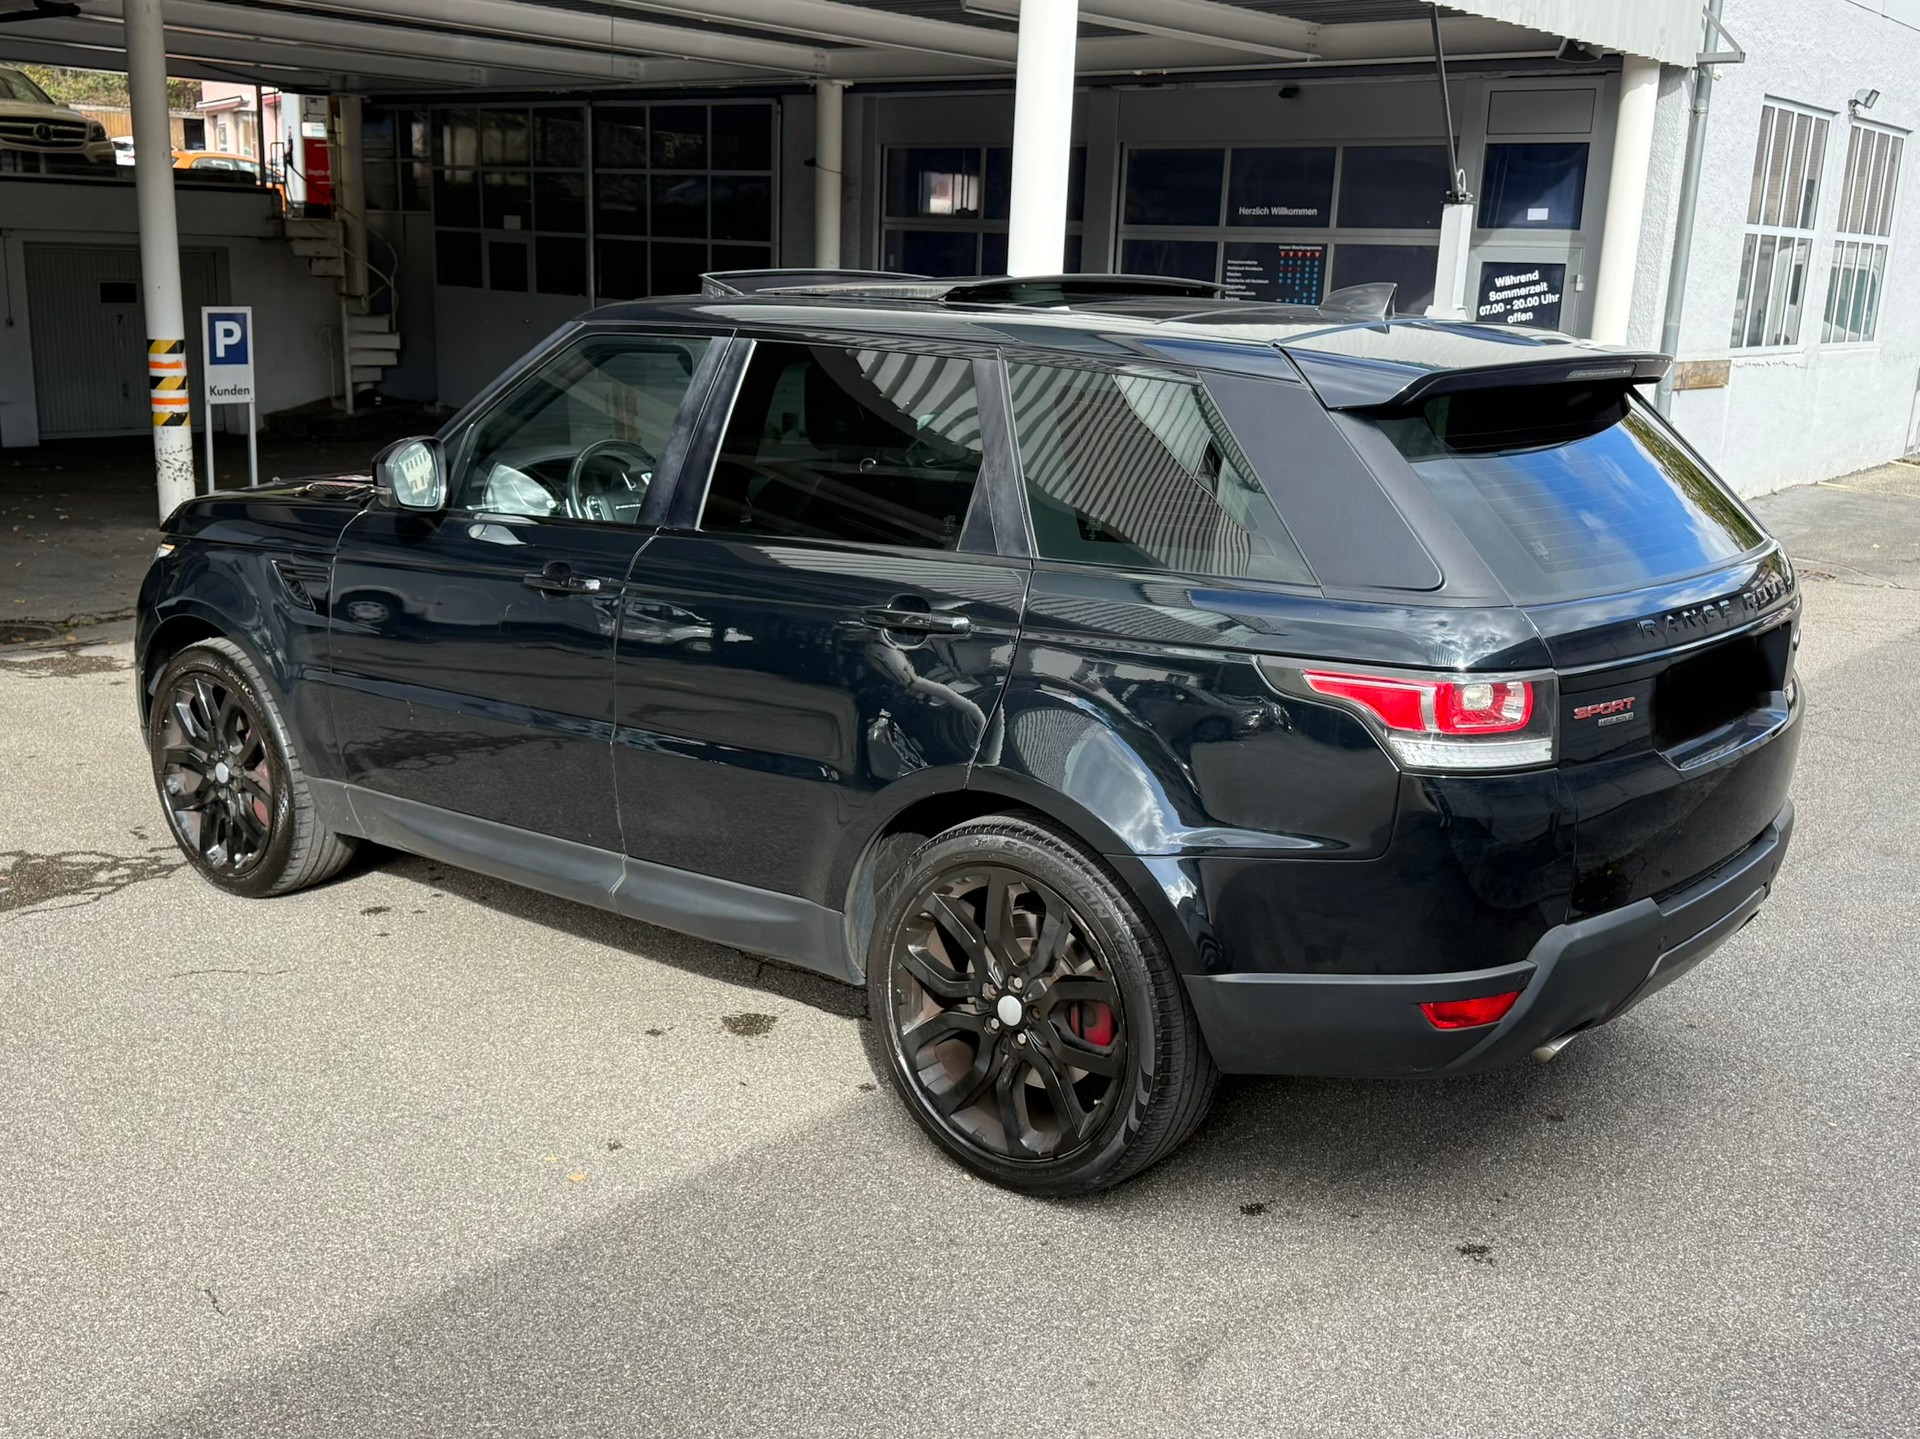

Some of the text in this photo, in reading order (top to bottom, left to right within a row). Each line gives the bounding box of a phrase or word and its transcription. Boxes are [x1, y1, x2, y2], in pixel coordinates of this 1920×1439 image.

[1239, 206, 1317, 215] Herzlich Willkommen
[1495, 270, 1539, 287] Während
[1489, 282, 1548, 301] Sommerzeit
[1479, 303, 1505, 316] 07.00
[1512, 296, 1540, 310] 20.00
[1541, 293, 1560, 305] Uhr
[116, 314, 123, 325] 7
[1507, 312, 1533, 324] offen
[215, 321, 242, 357] P
[209, 384, 250, 397] Kunden
[1636, 599, 1732, 639] RANGE
[1574, 696, 1636, 720] SPORT
